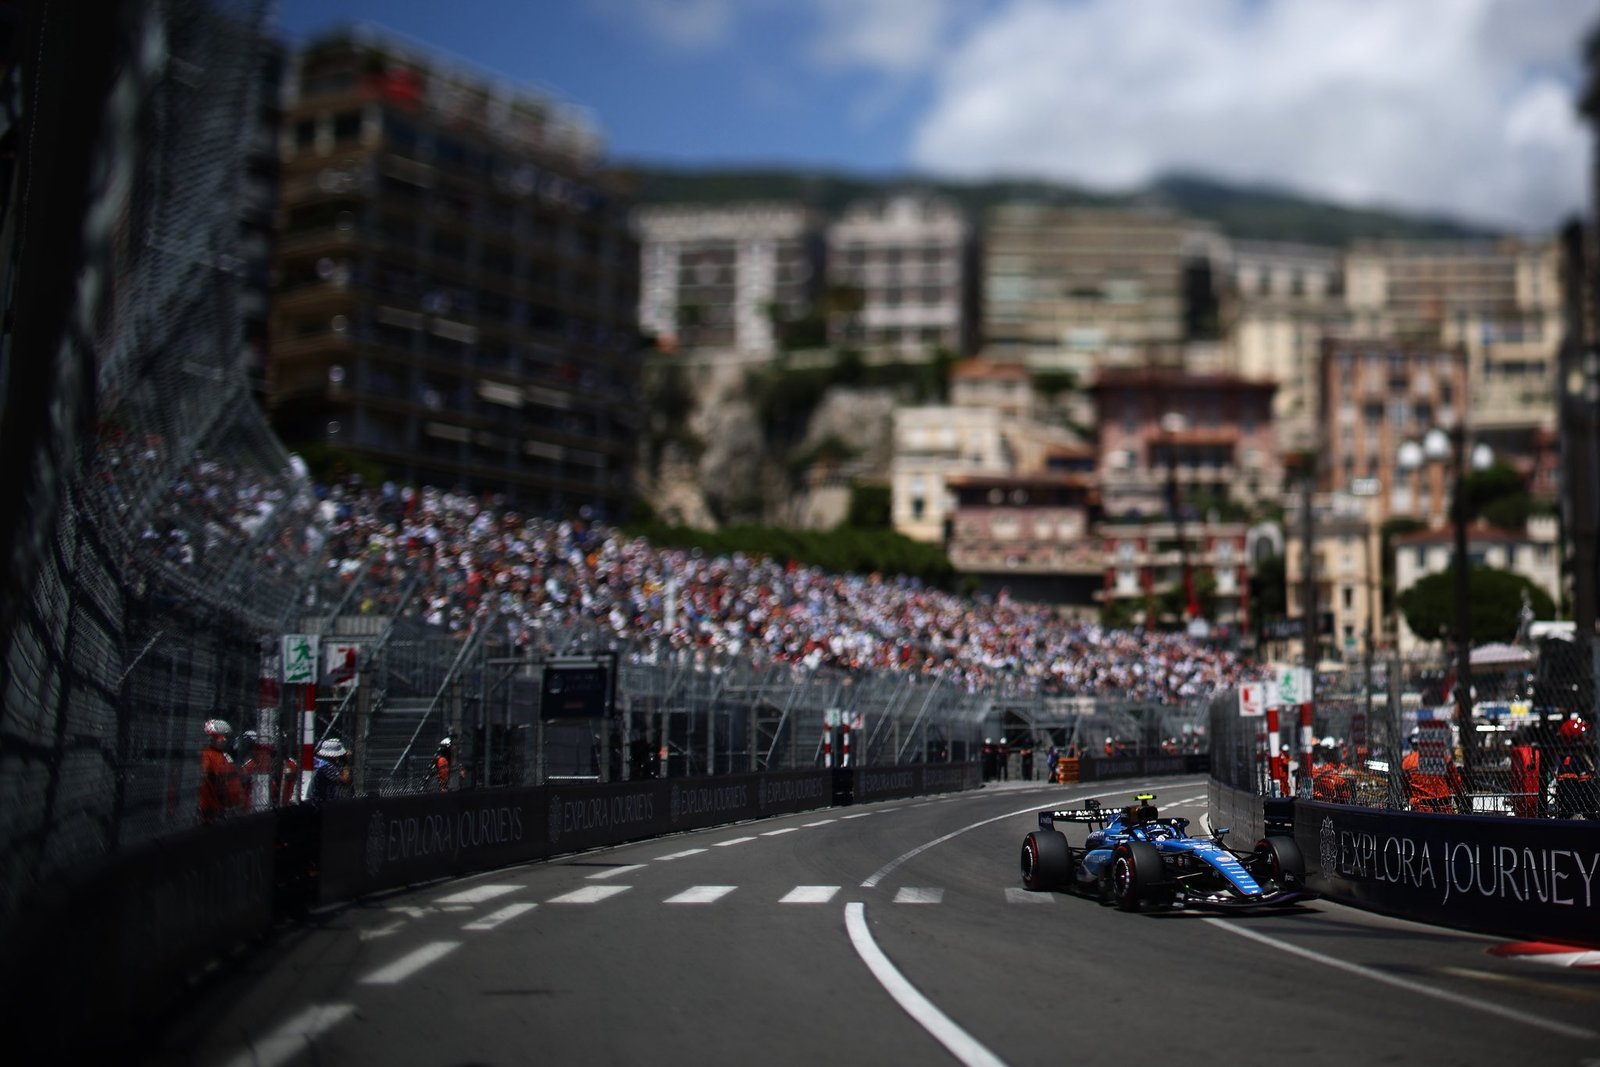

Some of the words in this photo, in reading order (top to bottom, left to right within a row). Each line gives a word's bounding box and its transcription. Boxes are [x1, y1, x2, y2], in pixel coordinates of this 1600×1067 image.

[563, 796, 609, 833] EXPLORA
[609, 792, 655, 832] JOURNEYS
[681, 789, 712, 815] EXPLORA
[1053, 808, 1122, 817] ATLAIAN
[388, 814, 455, 861] EXPLORA
[454, 807, 524, 861] JOURNEYS
[1340, 831, 1437, 889] EXPLORA
[1442, 841, 1600, 908] JOURNEY
